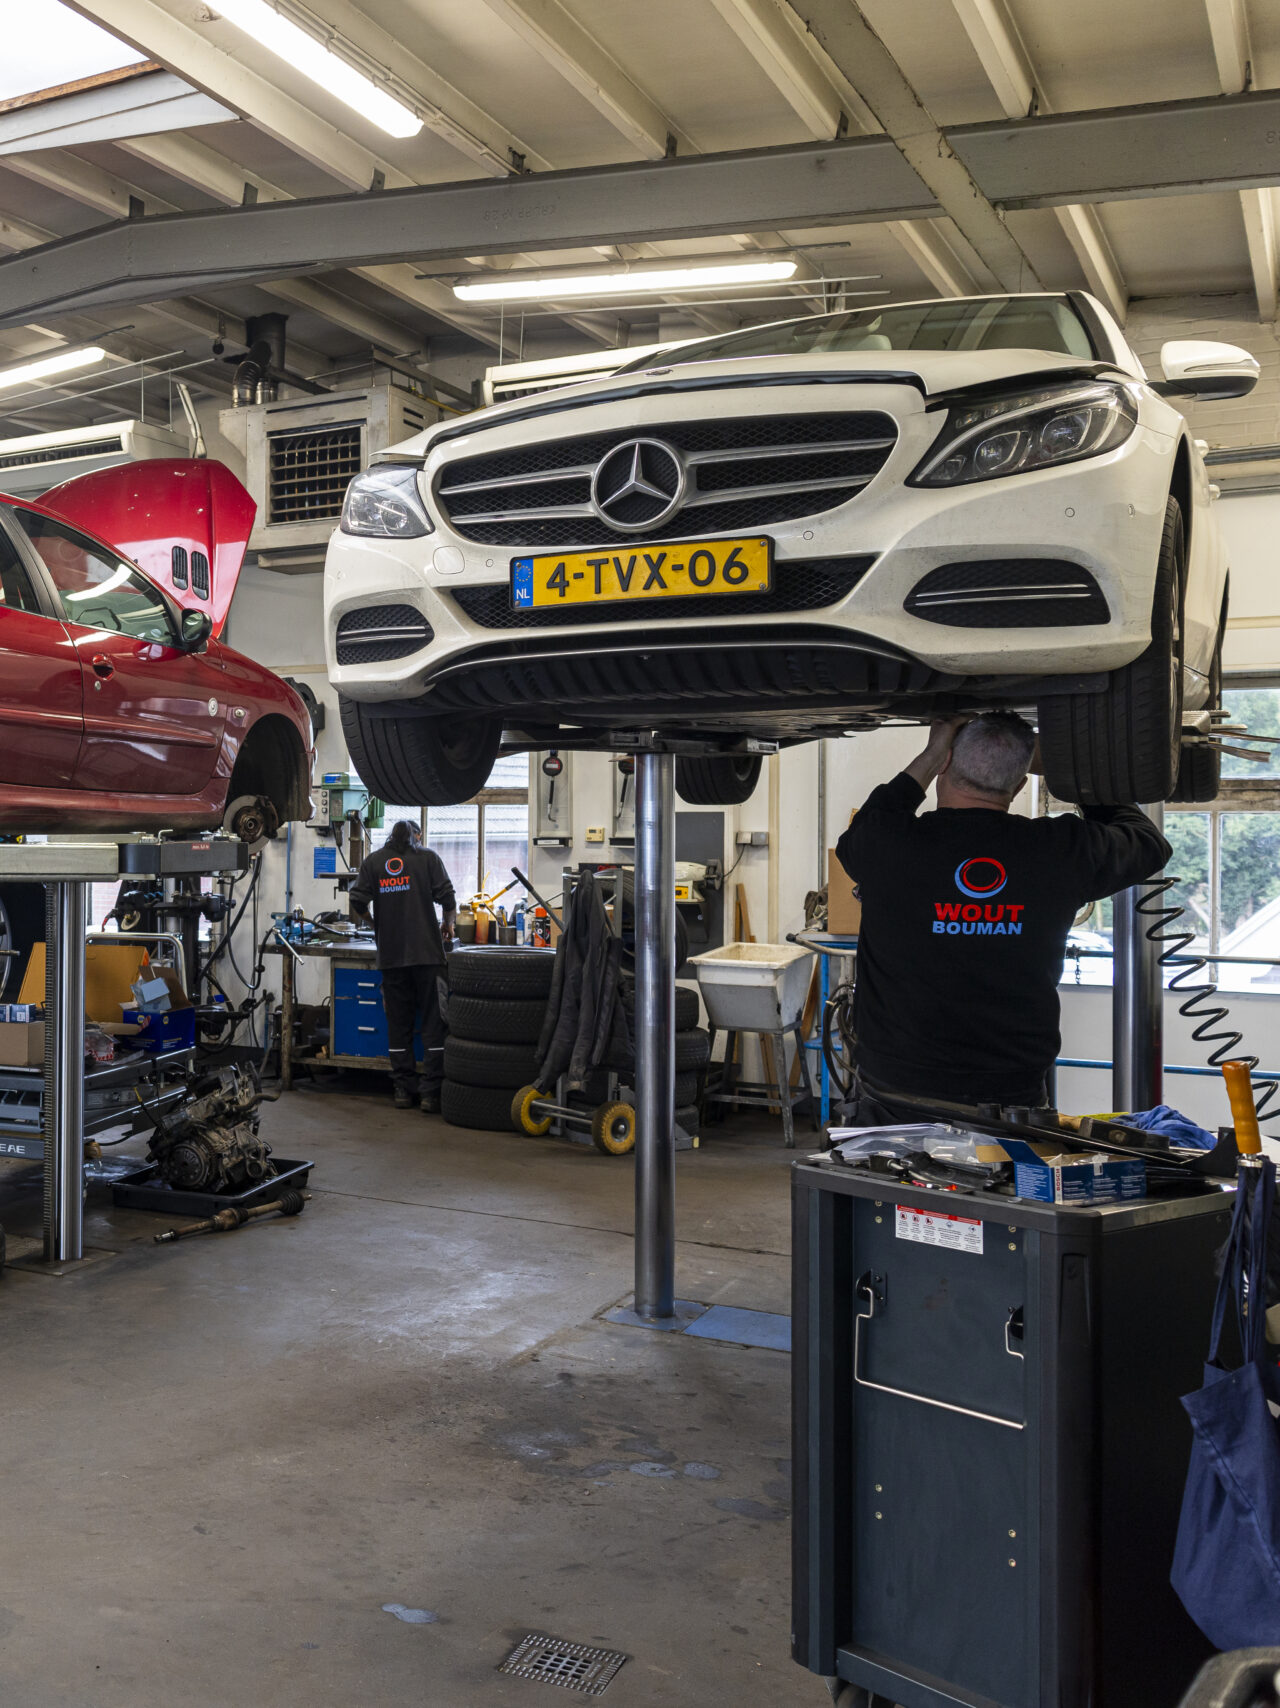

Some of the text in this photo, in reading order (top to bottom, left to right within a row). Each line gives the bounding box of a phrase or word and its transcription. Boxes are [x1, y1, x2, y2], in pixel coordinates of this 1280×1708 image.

[546, 547, 749, 597] 4-TVX-06
[516, 588, 531, 600] NL
[379, 876, 411, 887] WOUT
[934, 903, 1025, 922] WOUT
[932, 920, 1023, 935] BOUMAN
